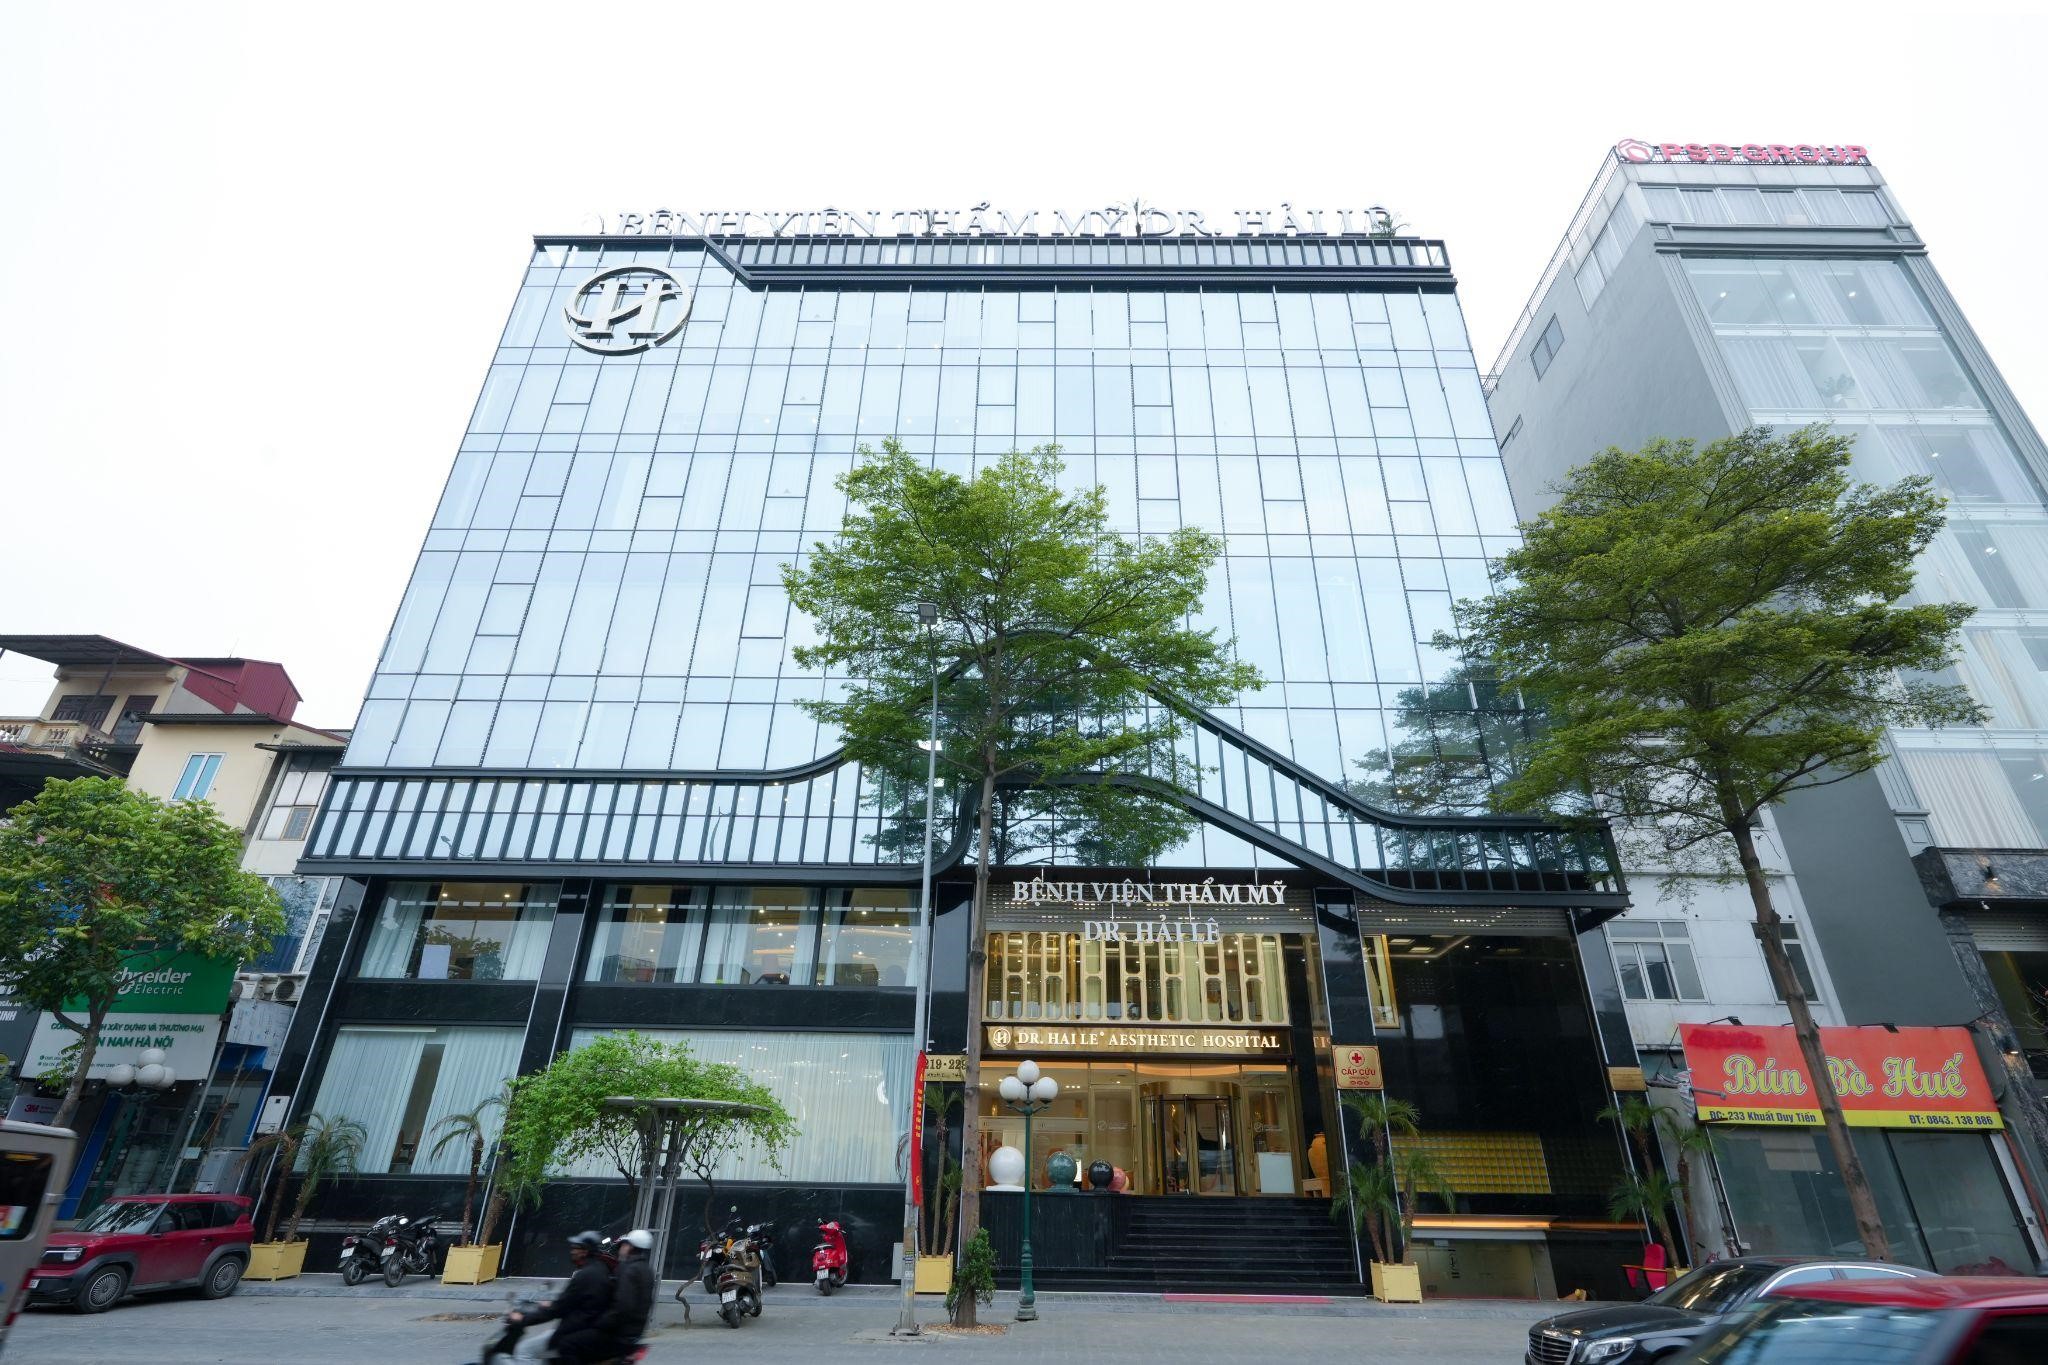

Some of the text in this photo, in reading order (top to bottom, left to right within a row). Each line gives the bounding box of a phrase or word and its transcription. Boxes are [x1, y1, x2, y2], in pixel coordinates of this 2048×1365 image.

[1659, 143, 1867, 163] PSD GROUP
[1140, 208, 1222, 237] DR.
[1012, 877, 1287, 907] BỆNH VIỆN THẨM MỸ
[1082, 915, 1220, 944] DR. HẢI LÊ
[112, 966, 192, 984] chneider
[134, 984, 184, 994] Electric
[107, 1037, 134, 1048] NAM
[135, 1036, 151, 1048] HÀ
[153, 1036, 174, 1050] NỘI
[1017, 1032, 1044, 1045] DR.
[1047, 1033, 1077, 1046] HAI
[1108, 1034, 1196, 1047] AESTHETIC
[1203, 1035, 1280, 1048] HOSPITAL
[1723, 1053, 1808, 1096] Bún
[1882, 1052, 1968, 1098] Huế
[1728, 1111, 1745, 1121] 233
[1777, 1112, 1794, 1123] Duy
[1909, 1114, 1925, 1124] ĐT:
[1927, 1115, 1953, 1126] 0843.
[1957, 1115, 1973, 1125] 138
[1975, 1115, 1993, 1125] 886
